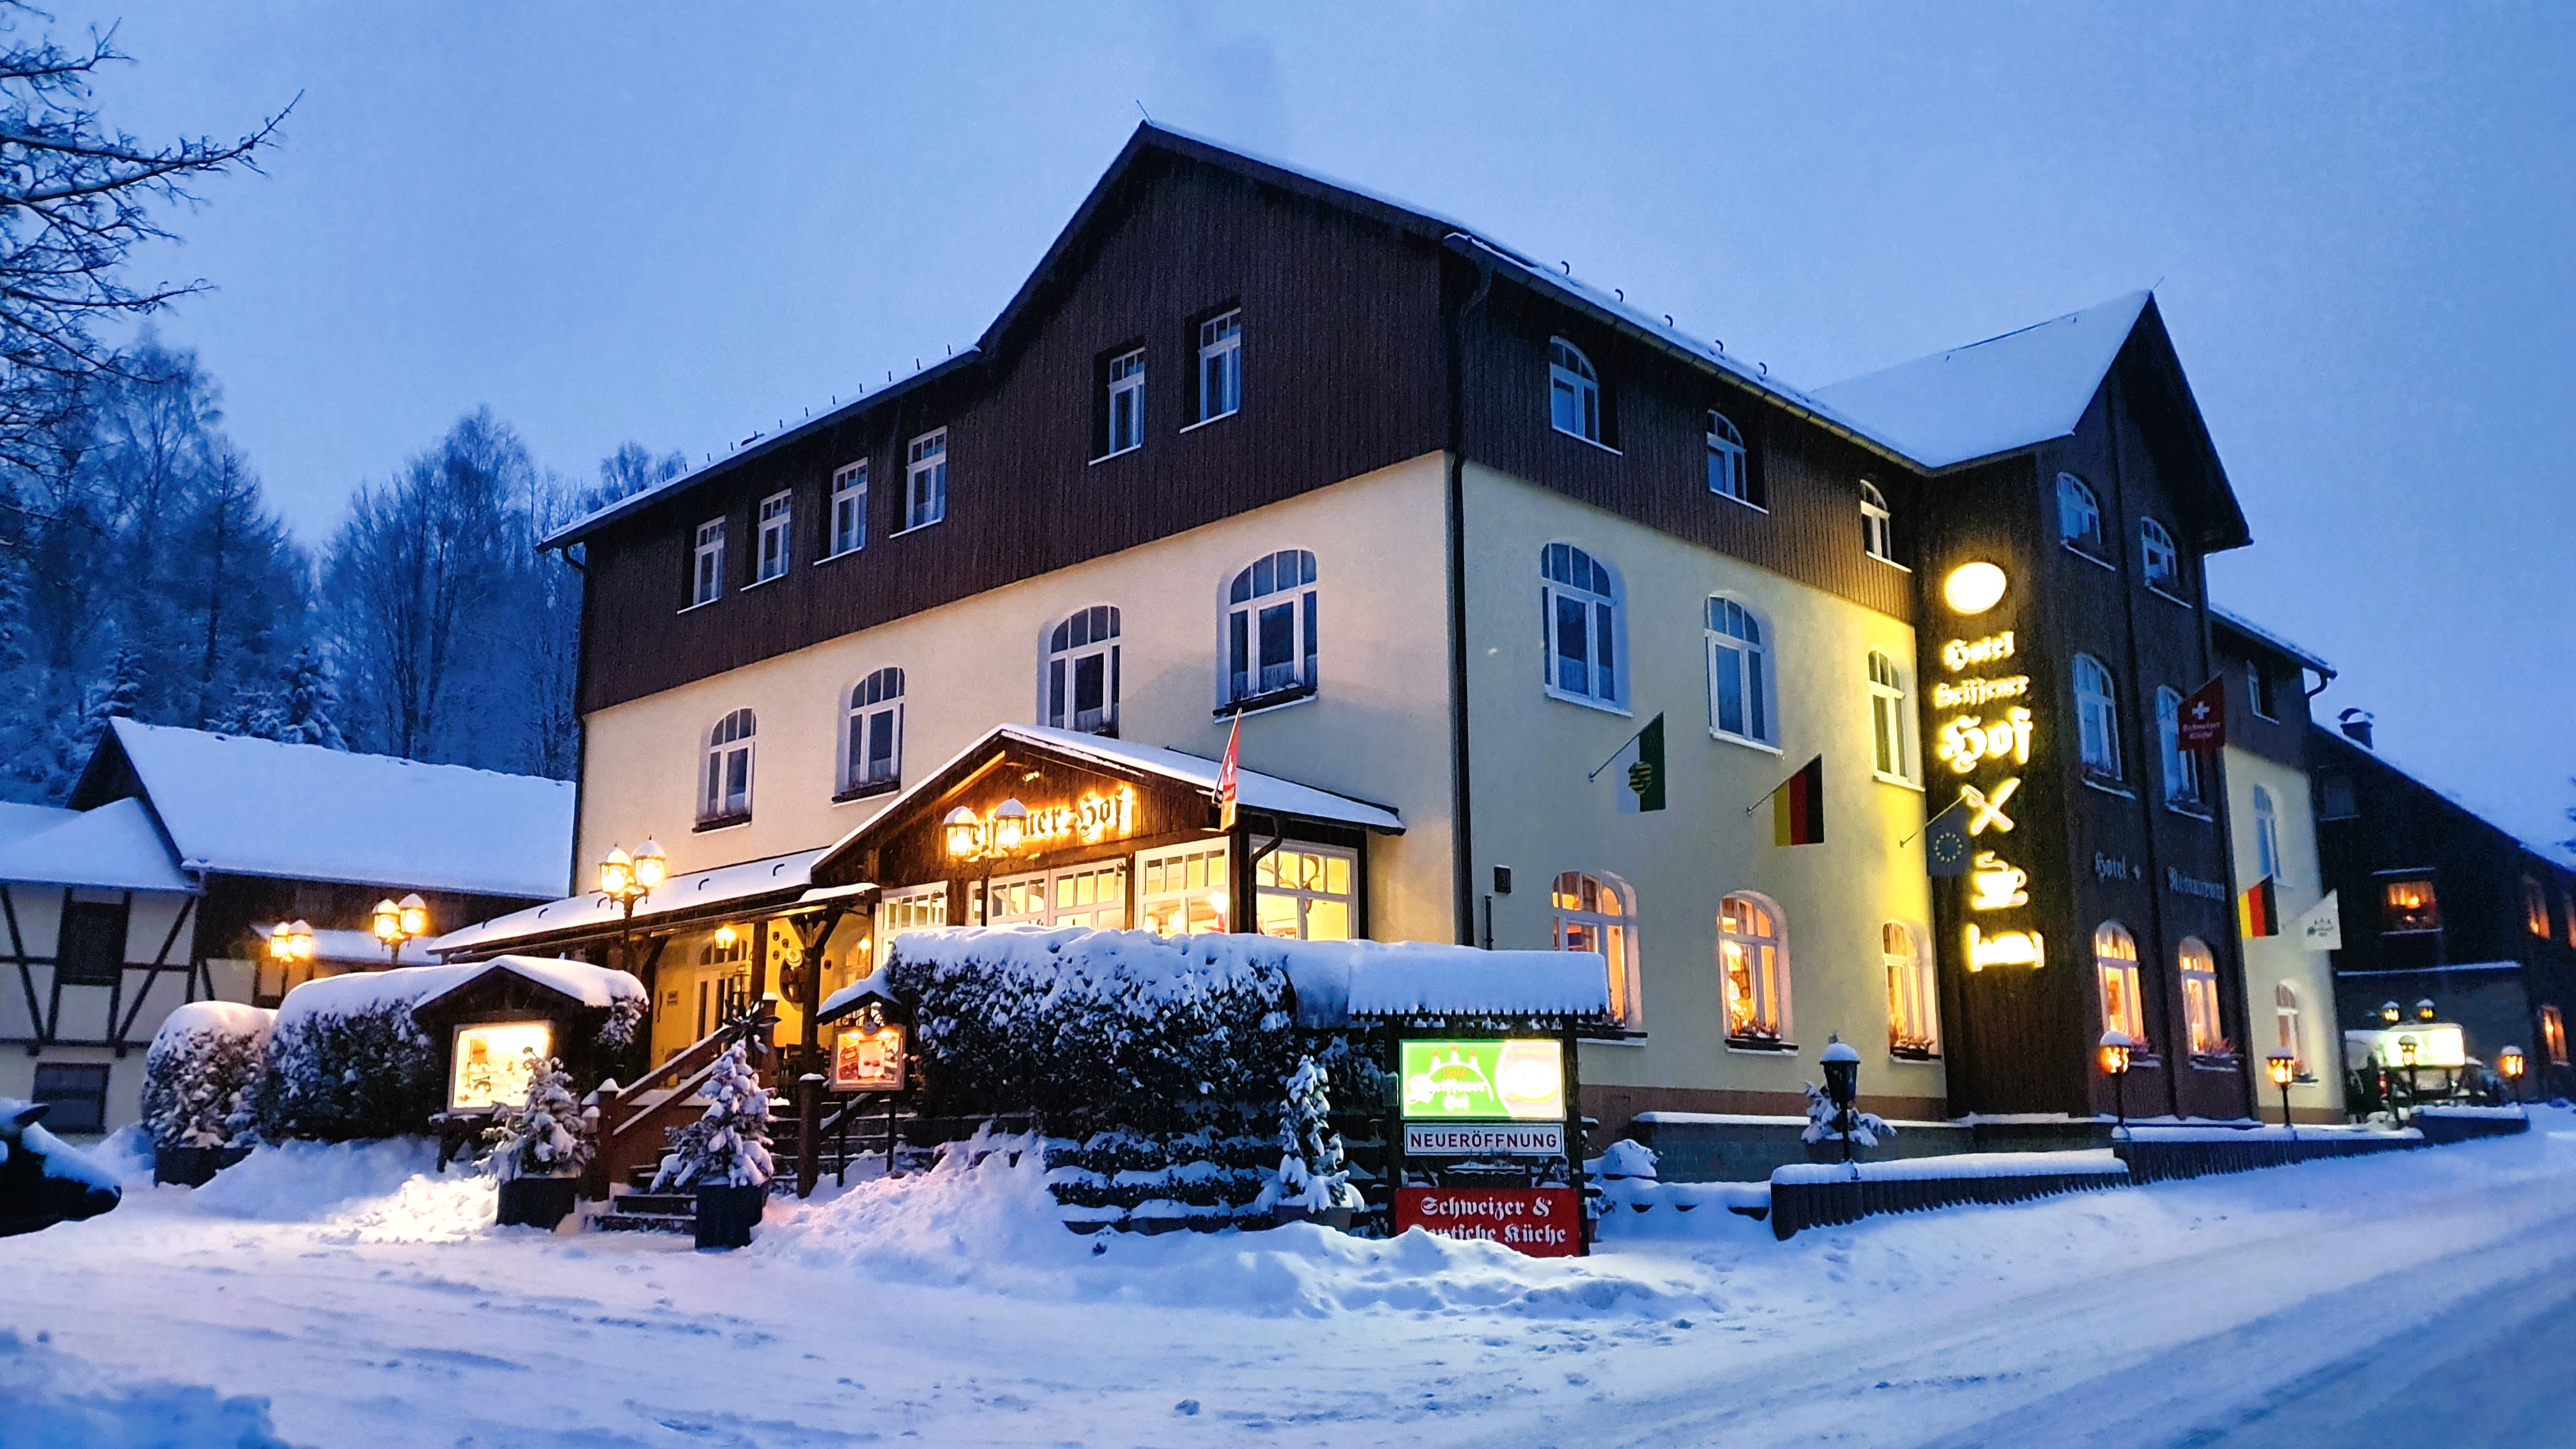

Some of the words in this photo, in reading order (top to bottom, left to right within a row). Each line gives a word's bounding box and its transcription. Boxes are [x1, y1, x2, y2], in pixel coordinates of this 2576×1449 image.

[1944, 631, 2015, 671] Hotel
[1936, 677, 2030, 707] Seiffener
[1940, 707, 2033, 773] Hof
[1443, 1068, 1468, 1077] Hotel
[1411, 1129, 1557, 1148] NEUERÖFFNUNG
[1420, 1196, 1525, 1220] Schweizer
[1532, 1196, 1552, 1217] &
[1504, 1223, 1567, 1246] Küche
